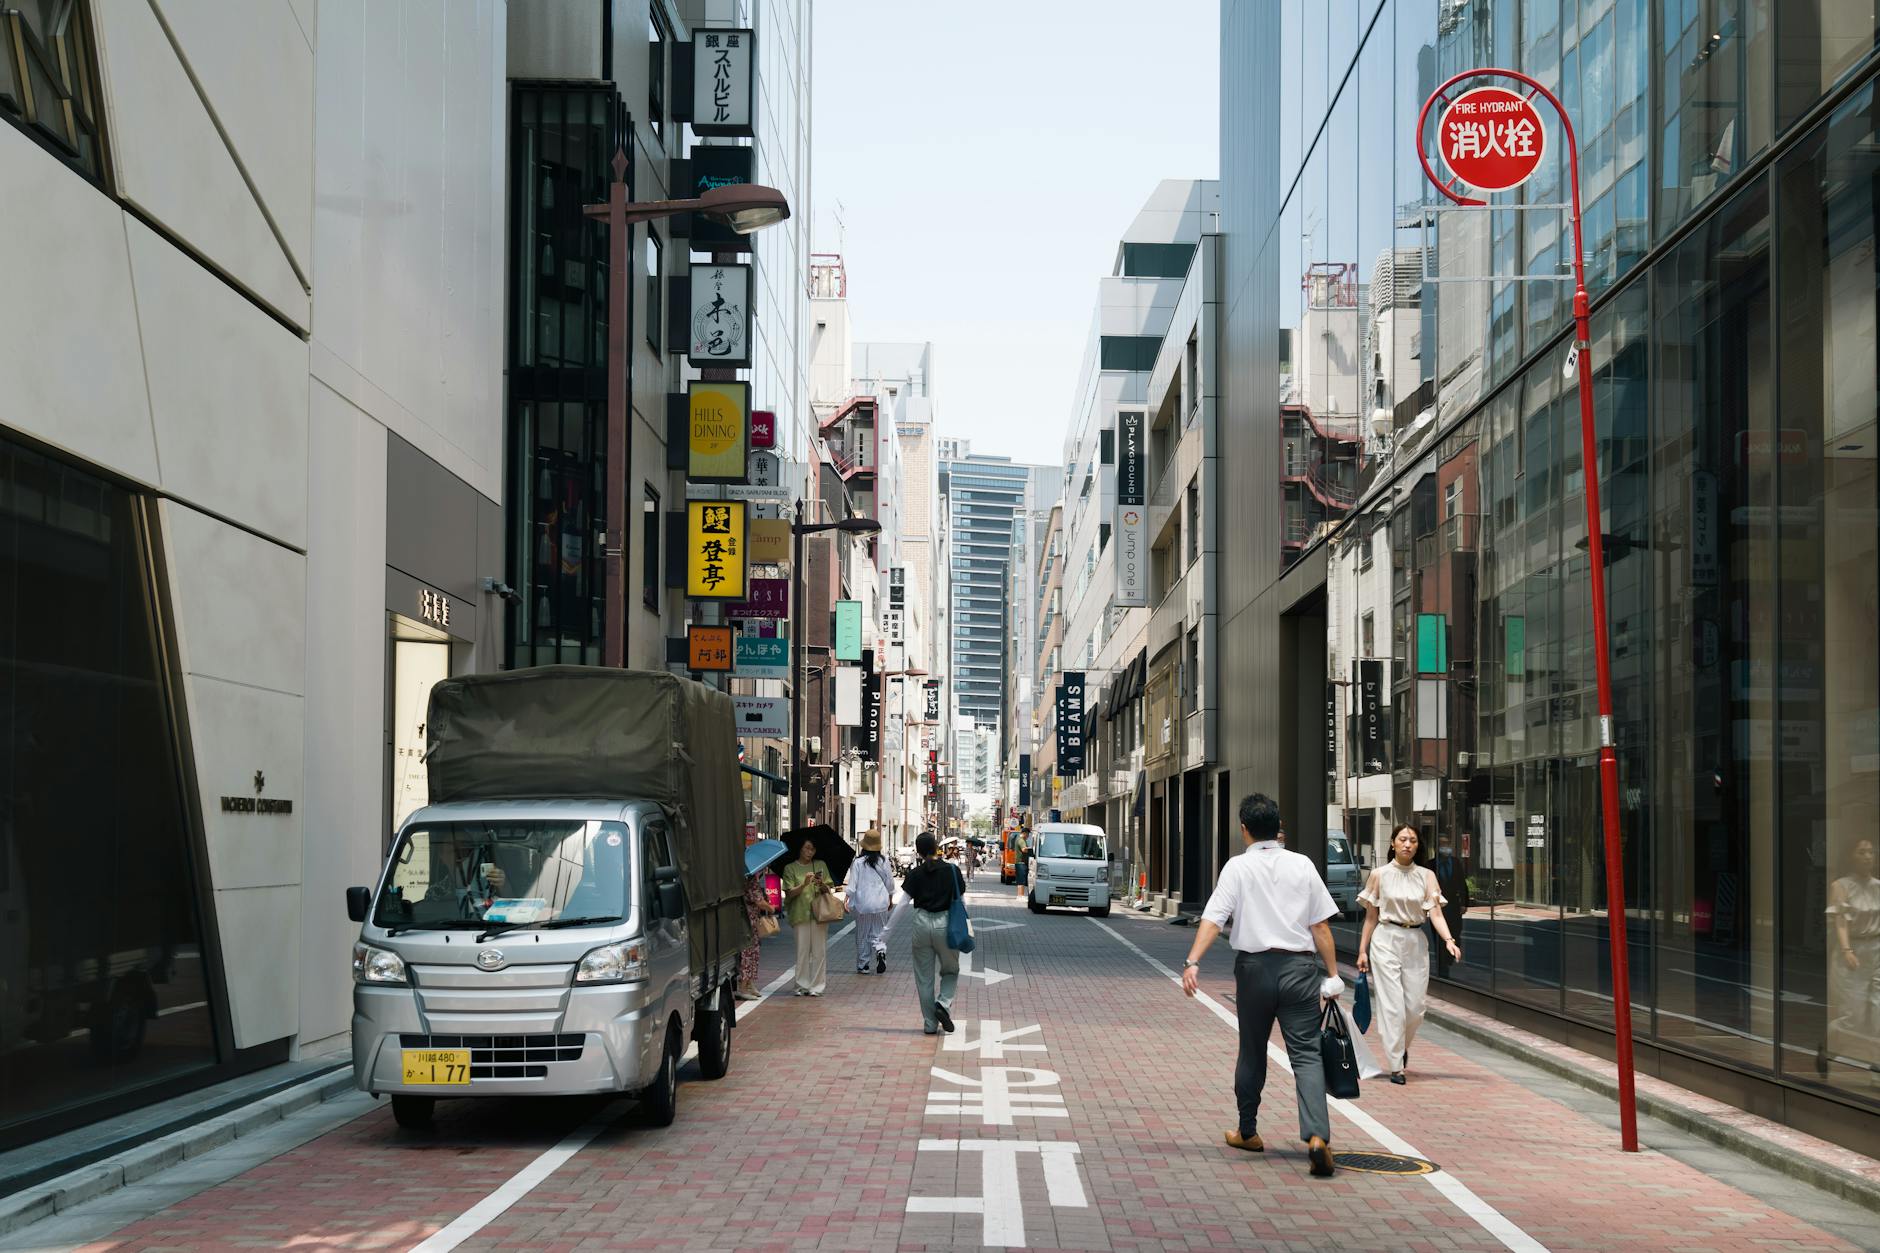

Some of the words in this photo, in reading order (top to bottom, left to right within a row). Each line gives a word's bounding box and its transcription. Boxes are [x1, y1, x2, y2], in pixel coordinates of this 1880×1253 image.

[705, 34, 740, 48] 銀座
[713, 49, 731, 122] スバルビル
[1456, 102, 1477, 114] FIRE
[1480, 101, 1524, 113] HYDRANT
[1449, 118, 1536, 160] 消火栓
[694, 407, 723, 421] HILLS
[694, 423, 736, 439] DINING
[1125, 529, 1136, 559] jump
[701, 539, 728, 591] 登亭
[1127, 562, 1135, 586] one
[732, 609, 781, 617] まつげエクステ
[1068, 685, 1081, 746] BEAMS
[752, 727, 782, 735] CAMERA
[438, 1053, 455, 1063] 480
